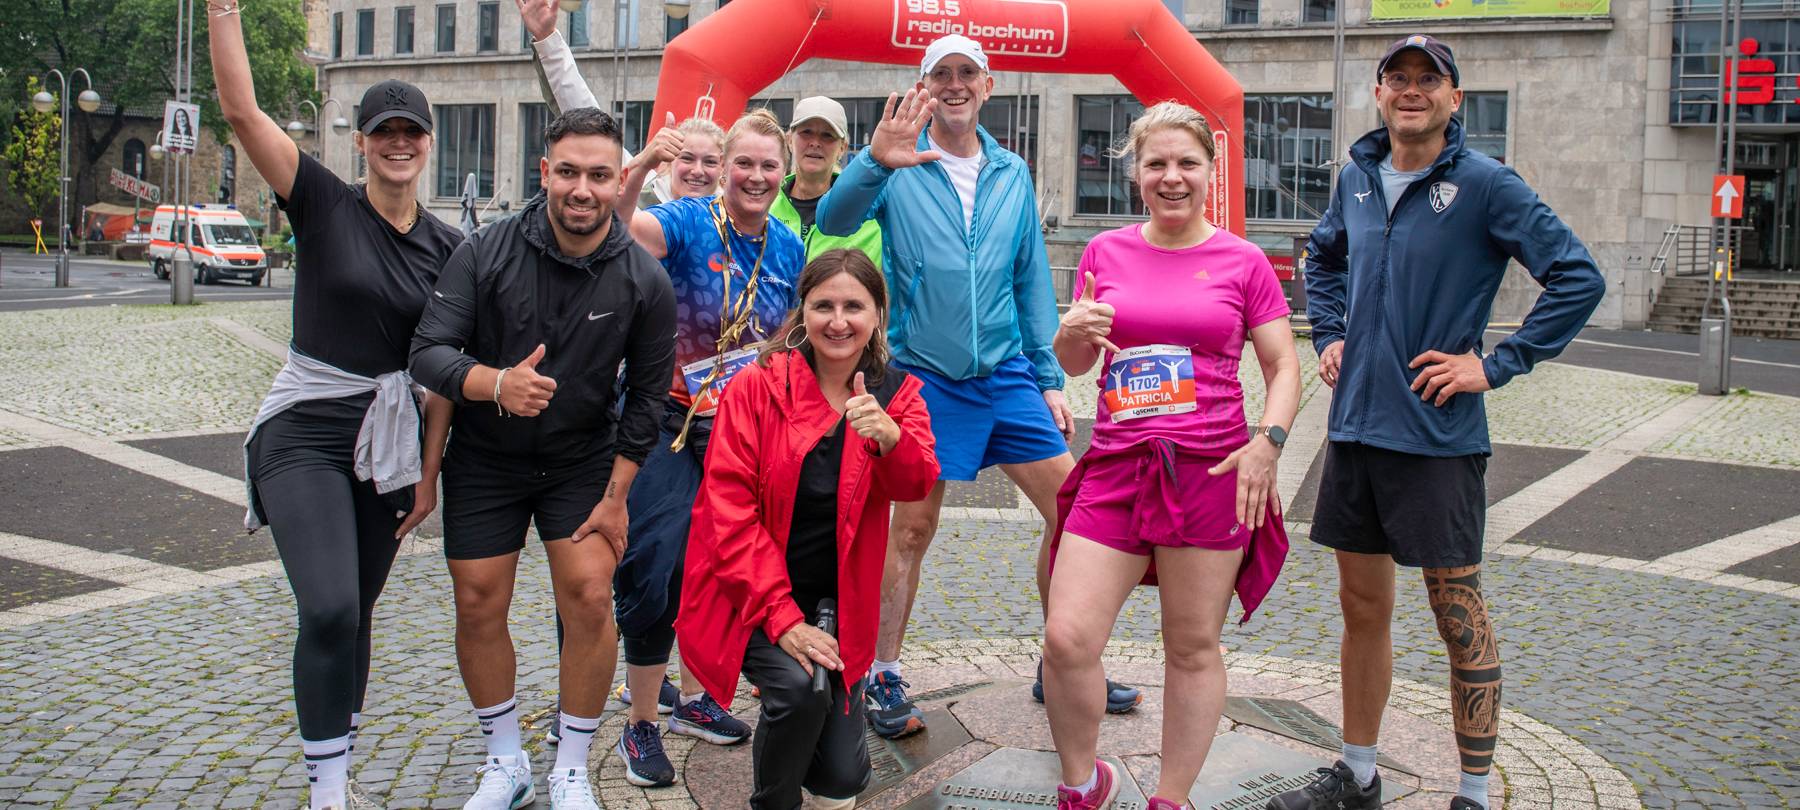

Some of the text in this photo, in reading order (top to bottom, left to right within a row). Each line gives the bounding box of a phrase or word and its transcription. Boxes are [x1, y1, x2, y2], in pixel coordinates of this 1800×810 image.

[907, 0, 961, 17] 98.5
[907, 19, 1055, 41] radio bochum
[1129, 376, 1160, 391] 1702
[1121, 392, 1173, 407] PATRICIA
